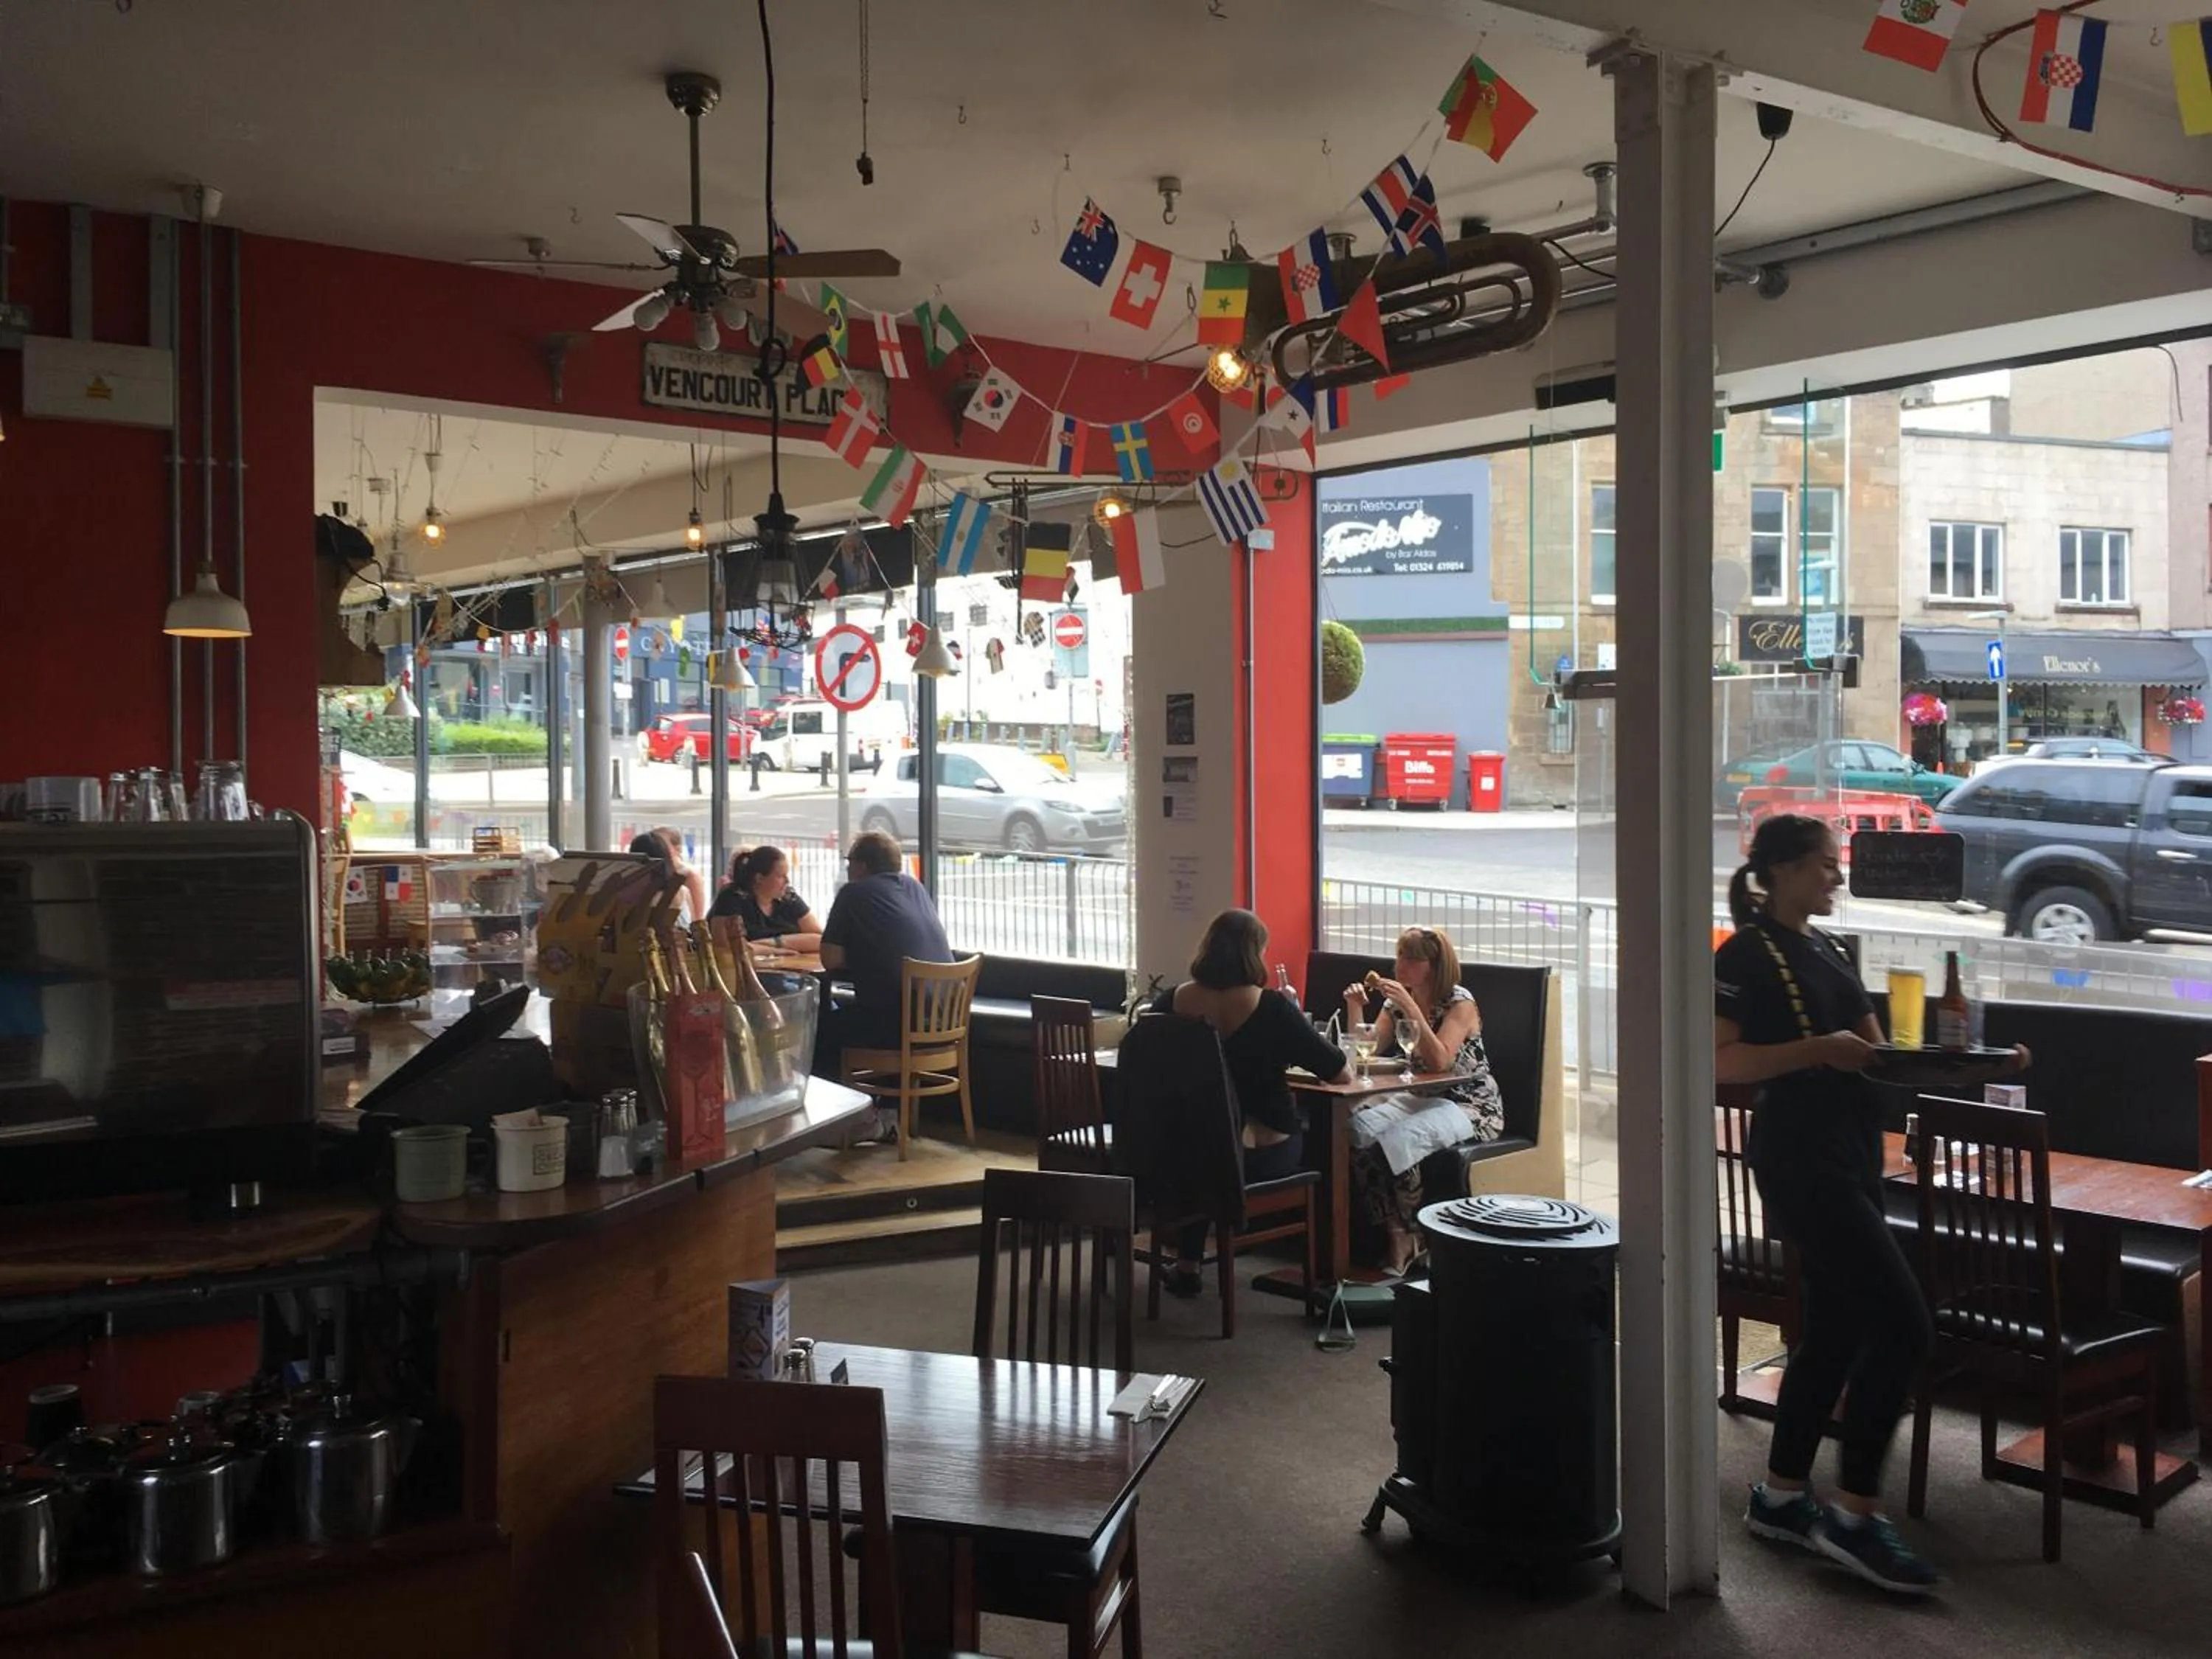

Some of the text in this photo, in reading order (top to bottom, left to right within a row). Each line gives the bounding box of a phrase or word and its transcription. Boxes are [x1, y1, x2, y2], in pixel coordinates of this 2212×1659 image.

[785, 383, 847, 417] PLAC
[1322, 498, 1424, 513] Italian Restaurant
